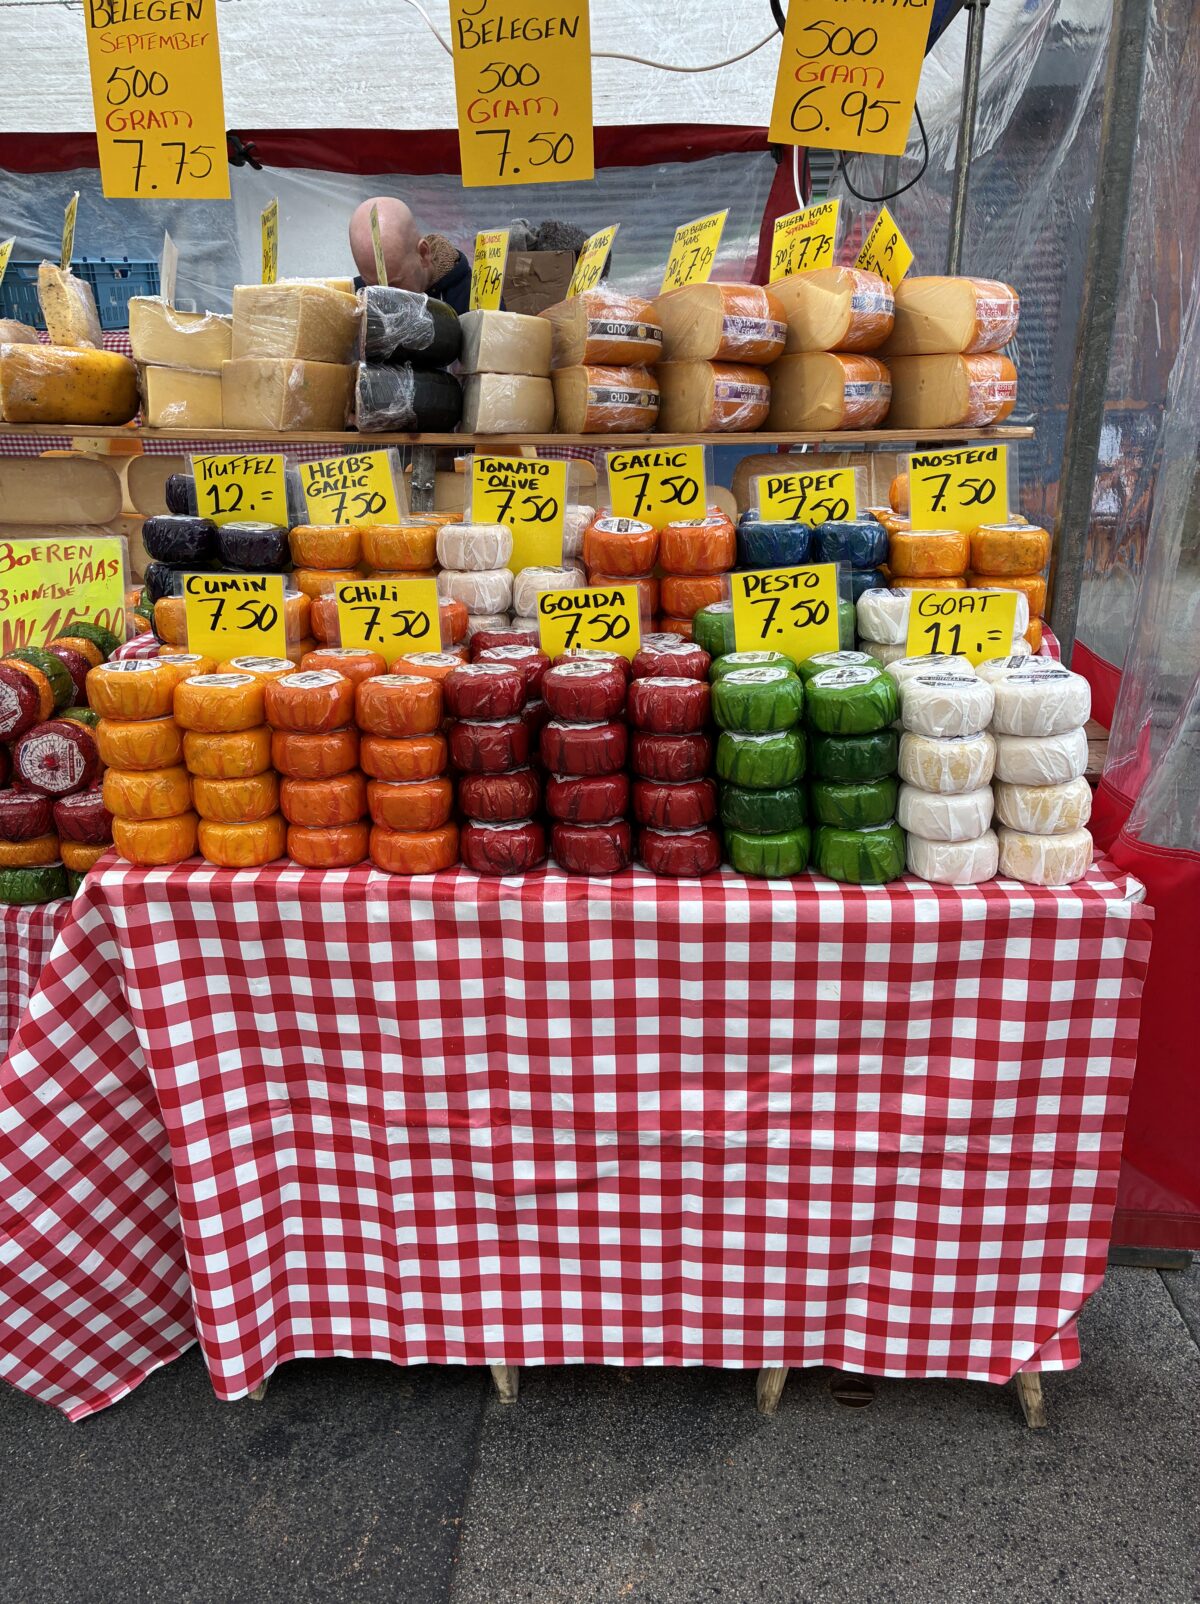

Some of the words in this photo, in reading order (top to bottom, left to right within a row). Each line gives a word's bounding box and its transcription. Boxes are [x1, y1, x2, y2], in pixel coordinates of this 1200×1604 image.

[89, 0, 203, 29] BELEGEN
[457, 16, 580, 49] BELEGEN
[796, 20, 878, 58] 500
[106, 65, 169, 105] 500
[477, 62, 541, 94] 500
[790, 85, 901, 137] 6.95
[113, 139, 216, 192] 7.75
[475, 129, 575, 177] 7.50
[775, 213, 805, 233] BELEGEN
[808, 204, 833, 220] KAAS
[797, 234, 834, 270] 7.75
[858, 216, 884, 265] BELEGEN
[481, 265, 503, 296] 7.95
[684, 246, 715, 282] 7.95
[606, 323, 627, 335] OUD
[610, 392, 630, 403] OUD
[474, 457, 550, 476] TOMATO
[322, 491, 387, 524] 7.50
[484, 489, 559, 524] 7.50
[623, 473, 699, 517] 7.50
[921, 473, 997, 512] 7.50
[69, 559, 119, 587] KAAS
[743, 572, 820, 598] PESTO
[197, 598, 278, 632] 7.50
[540, 591, 626, 615] GOUDA
[749, 597, 831, 639] 7.50
[918, 593, 1001, 617] GOAT
[350, 607, 431, 643] 7.50
[551, 612, 631, 649] 7.50
